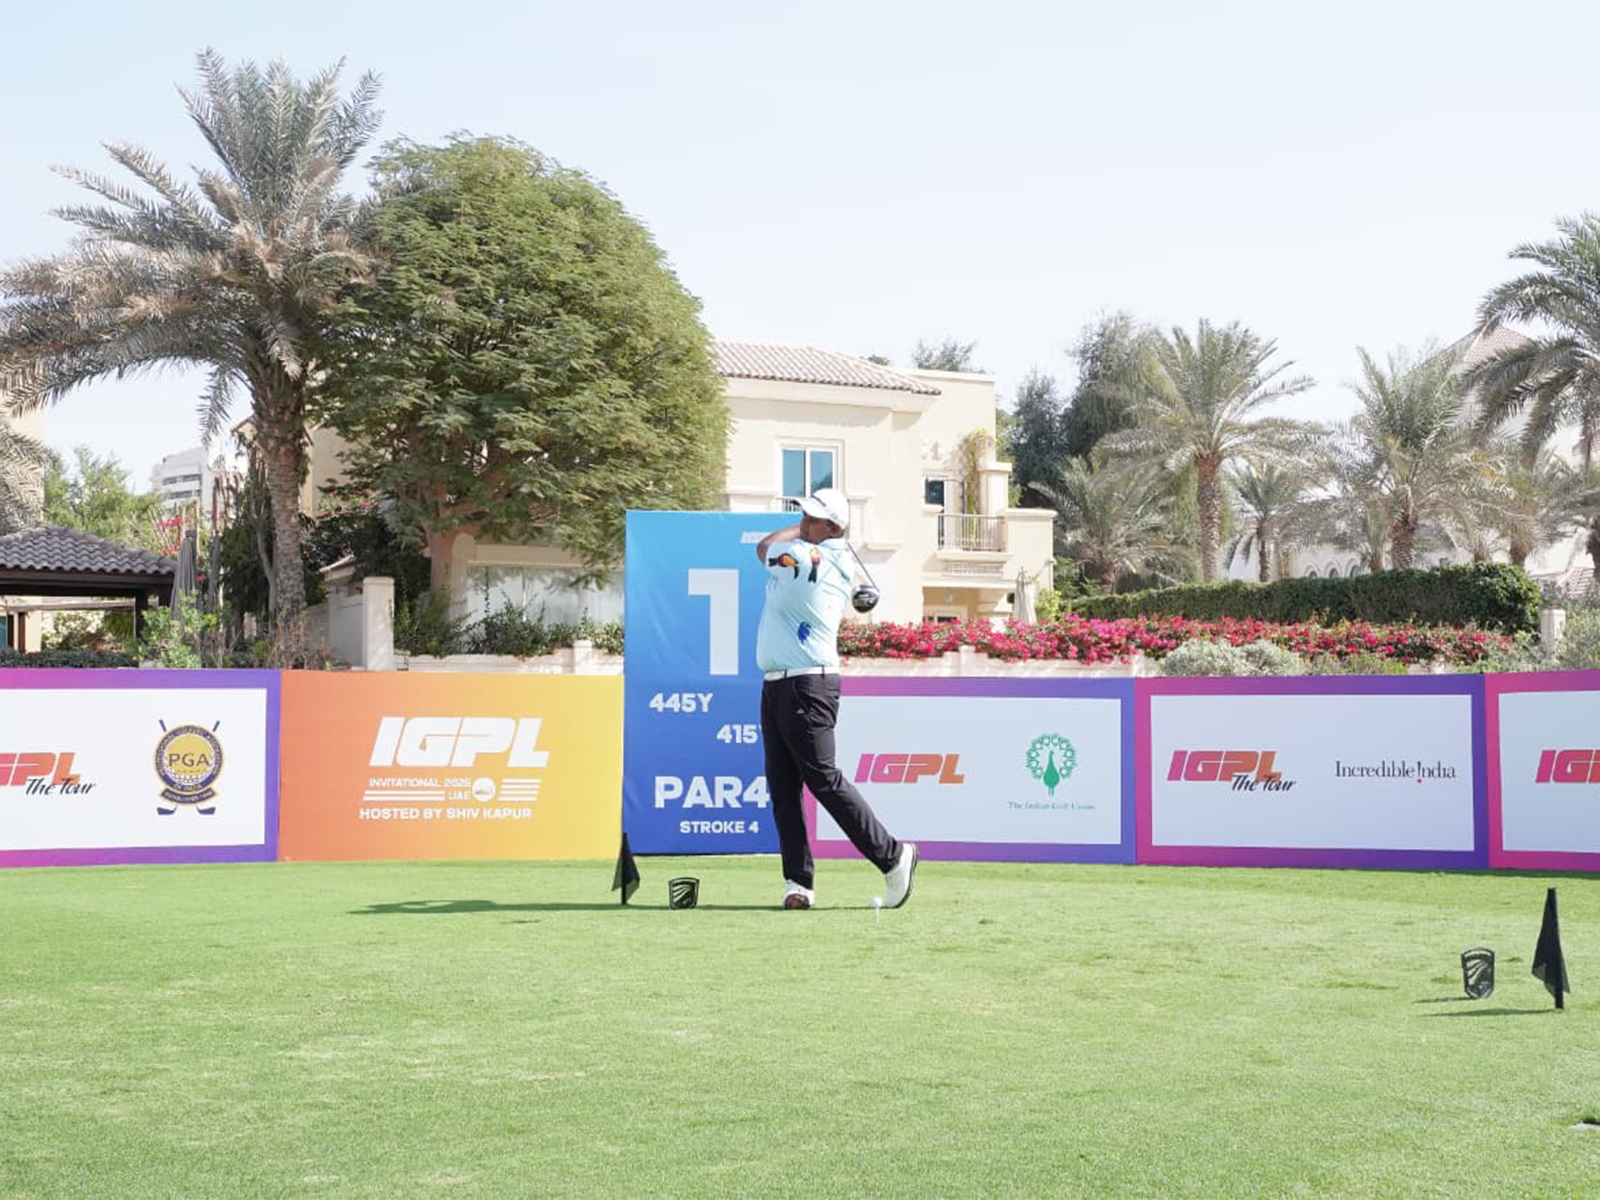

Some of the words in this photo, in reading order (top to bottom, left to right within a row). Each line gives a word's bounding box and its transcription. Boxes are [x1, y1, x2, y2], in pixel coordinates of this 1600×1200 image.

[687, 568, 739, 676] 1
[649, 692, 714, 713] 445Y
[369, 717, 550, 767] IGPL
[716, 723, 763, 744] 415
[168, 753, 211, 768] PGA
[853, 753, 966, 785] IGPL
[1166, 749, 1282, 783] IGPL
[1535, 749, 1600, 783] IG
[25, 777, 56, 796] The
[58, 777, 97, 795] Tour
[369, 777, 441, 788] INVITATIONAL
[653, 775, 771, 809] PAR4
[1230, 774, 1259, 792] The
[1262, 774, 1297, 792] Tour
[448, 790, 472, 801] UAE
[359, 807, 420, 820] HOSTED
[423, 807, 442, 820] BY
[446, 808, 480, 820] SHIV
[483, 808, 532, 821] KAPUR
[679, 821, 745, 834] STROKE
[748, 821, 760, 834] 4
